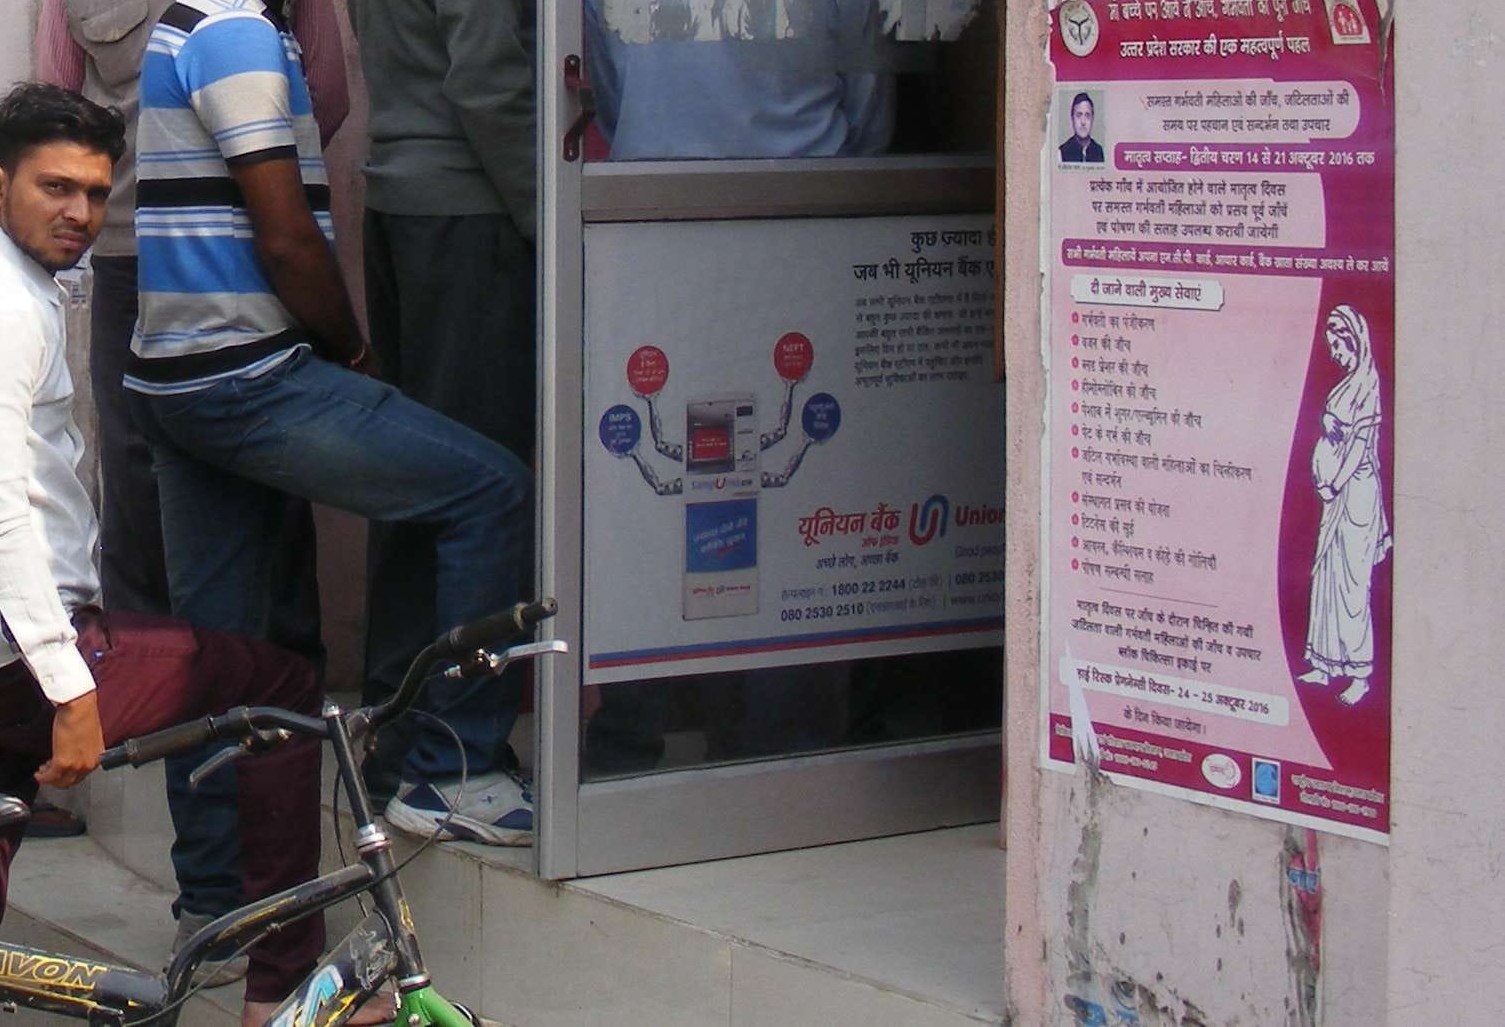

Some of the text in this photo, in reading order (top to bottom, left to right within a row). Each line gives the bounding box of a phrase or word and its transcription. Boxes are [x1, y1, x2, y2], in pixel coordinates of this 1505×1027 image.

[1120, 41, 1144, 58] उत्तर
[1146, 35, 1167, 57] प्रदेश
[1169, 39, 1202, 56] सरकार
[1203, 33, 1217, 56] की
[1219, 38, 1237, 56] एक
[1286, 36, 1310, 54] पहल
[1245, 90, 1257, 107] की
[1337, 88, 1350, 106] की
[1186, 118, 1198, 132] पर
[1301, 118, 1330, 132] उपचार
[1221, 151, 1243, 164] चरण
[1246, 151, 1258, 163] 14
[1261, 146, 1271, 165] से
[1275, 151, 1286, 163] 21
[1288, 149, 1325, 169] अक्टूबर
[1328, 151, 1352, 165] 2016
[1356, 151, 1375, 165] तक
[1207, 179, 1226, 195] वाले
[1260, 180, 1286, 197] दिवस
[1092, 200, 1102, 214] पर
[1105, 200, 1133, 214] समस्त
[1135, 196, 1165, 215] गर्भवती
[910, 231, 938, 253] कुछ
[853, 263, 878, 281] जब
[882, 258, 900, 280] भी
[904, 257, 954, 284] यूनियन
[1090, 277, 1099, 294] दी
[1102, 278, 1122, 296] जाने
[1125, 279, 1146, 297] वाली
[1149, 285, 1172, 303] मुख्य
[798, 502, 902, 547] यूनियन बैंक
[832, 581, 859, 597] 1800
[861, 580, 876, 594] 22
[781, 608, 803, 623] 080
[805, 605, 834, 620] 2530
[836, 602, 865, 617] 2510
[1178, 687, 1190, 699] 24
[1201, 692, 1213, 703] 25
[1248, 700, 1270, 715] 2016
